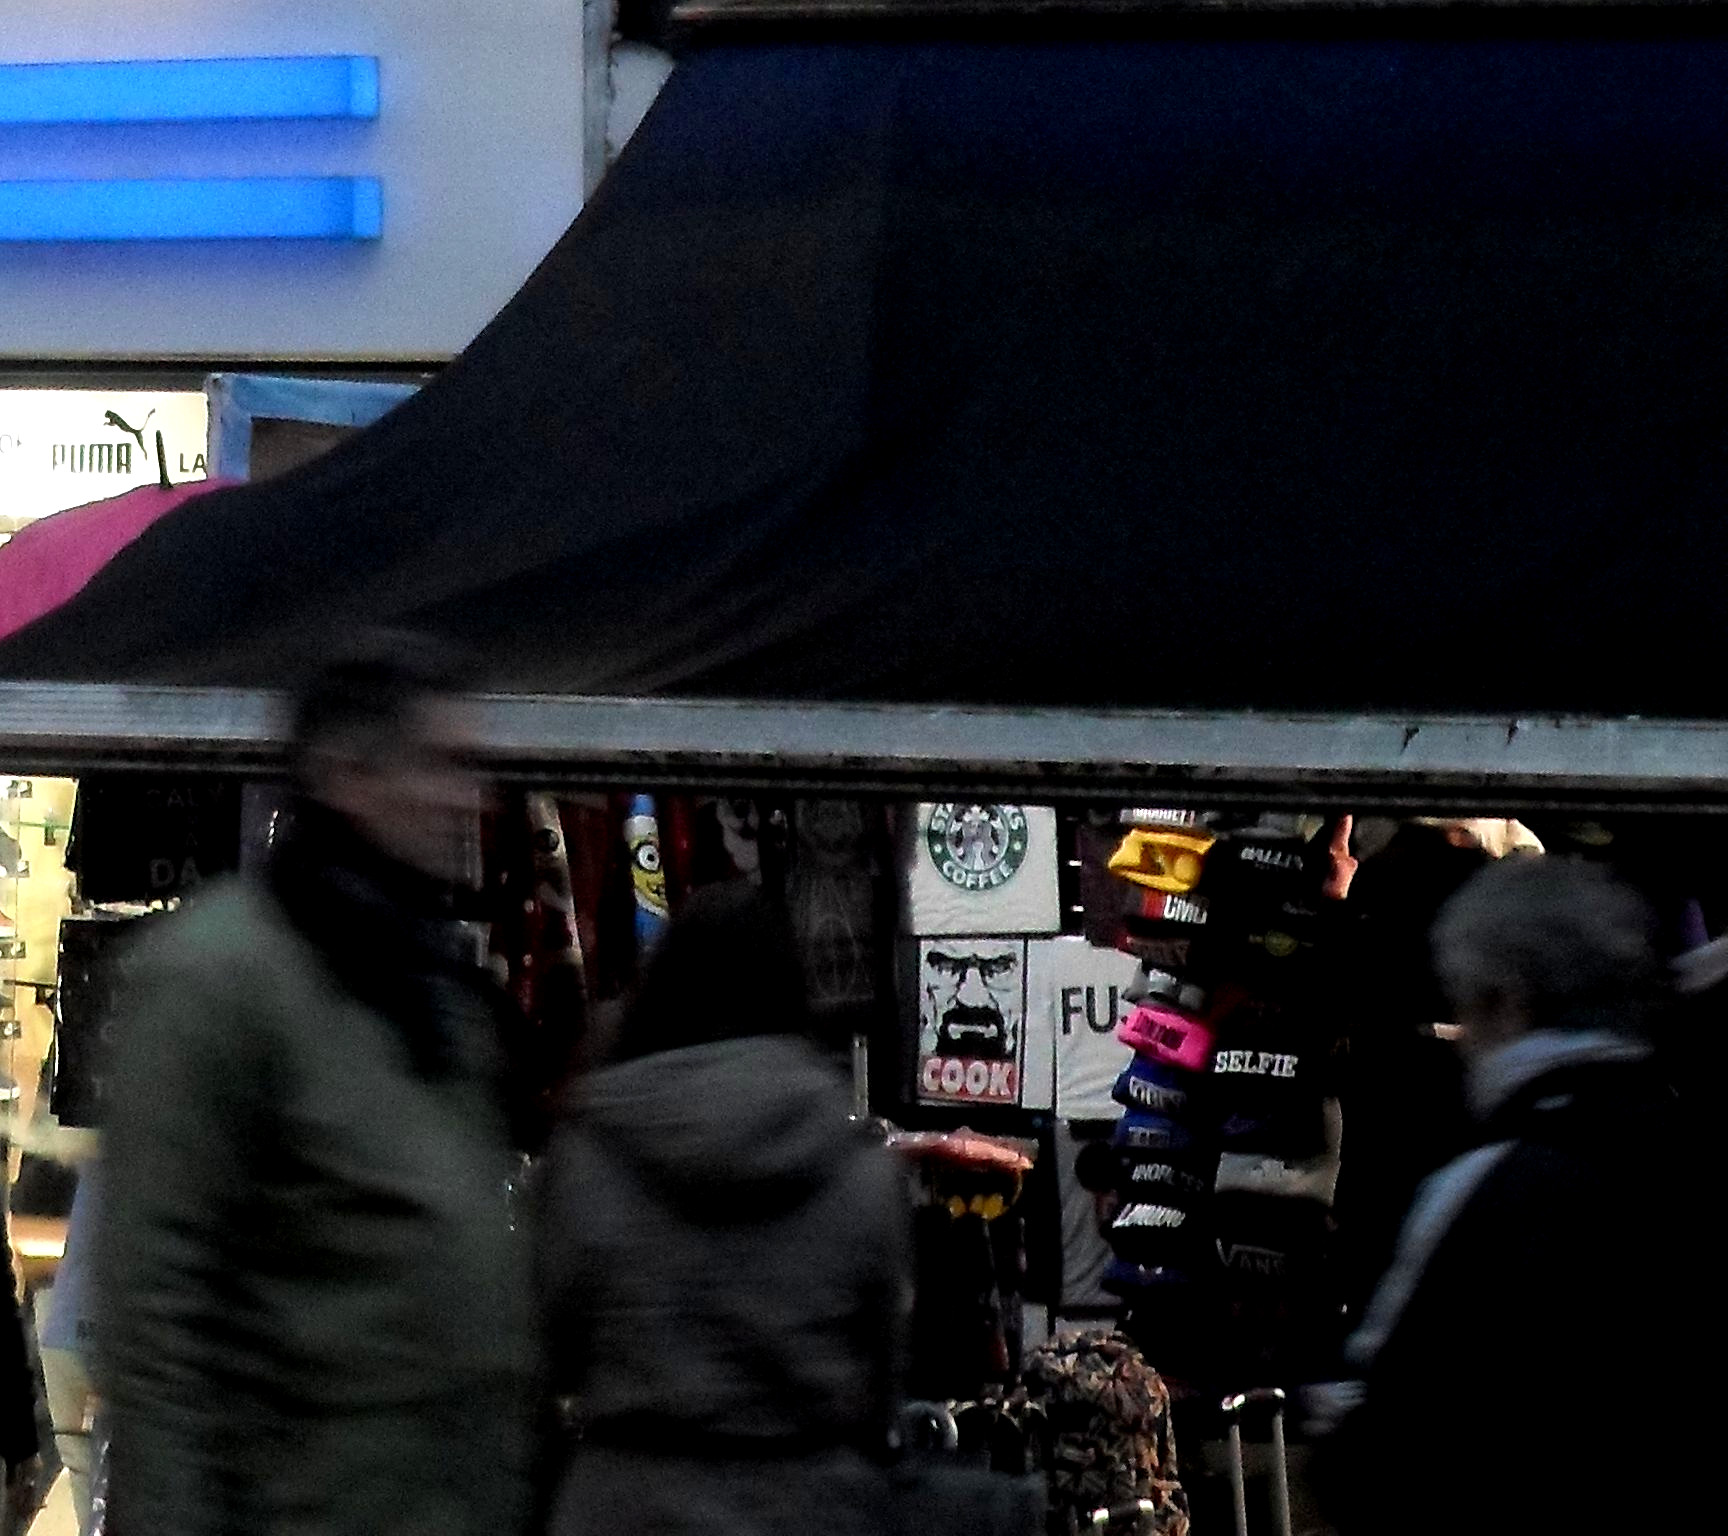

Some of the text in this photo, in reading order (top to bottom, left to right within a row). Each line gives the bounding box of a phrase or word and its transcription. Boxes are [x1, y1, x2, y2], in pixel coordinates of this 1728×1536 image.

[52, 443, 131, 475] PUMA
[942, 860, 1014, 888] COFFEE
[923, 1058, 1015, 1097] COOK
[1214, 1049, 1299, 1078] SELFIE
